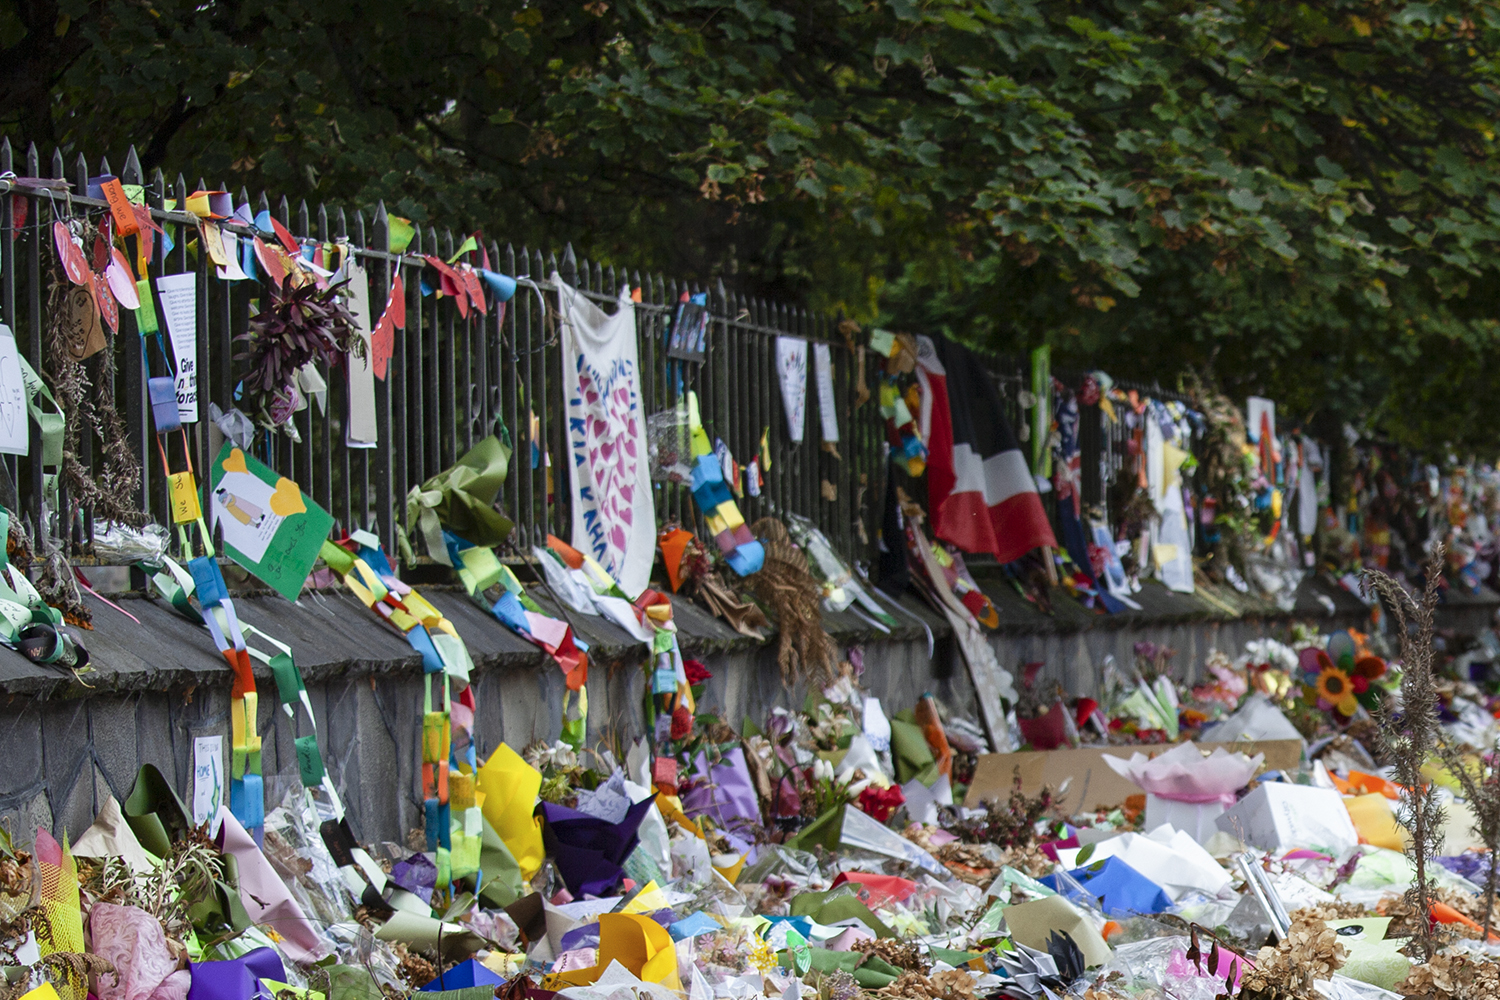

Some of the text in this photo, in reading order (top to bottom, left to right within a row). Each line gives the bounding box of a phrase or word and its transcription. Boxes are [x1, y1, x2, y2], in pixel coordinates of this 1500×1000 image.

[107, 181, 120, 205] rong
[181, 358, 194, 374] Give
[178, 499, 188, 516] We
[196, 764, 210, 778] HOME
